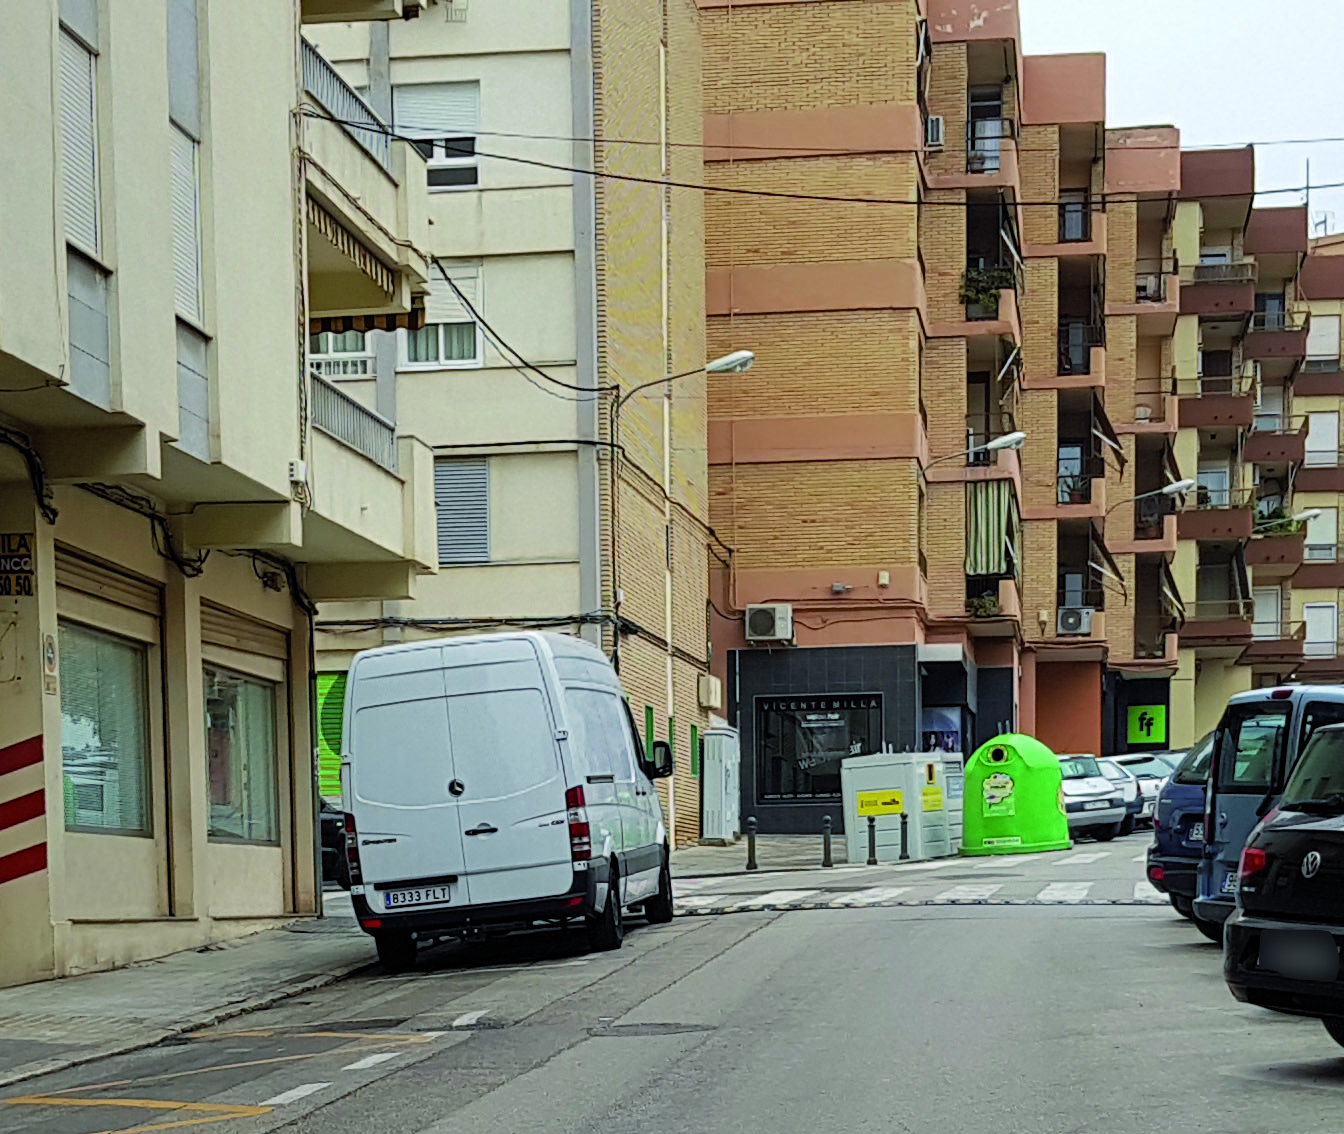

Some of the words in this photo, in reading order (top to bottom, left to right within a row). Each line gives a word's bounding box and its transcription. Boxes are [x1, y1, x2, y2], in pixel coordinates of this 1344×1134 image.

[15, 574, 31, 596] 50
[763, 701, 827, 711] VICENTE
[832, 699, 878, 709] MILLA
[392, 890, 422, 904] 8333
[425, 887, 448, 902] FLT
